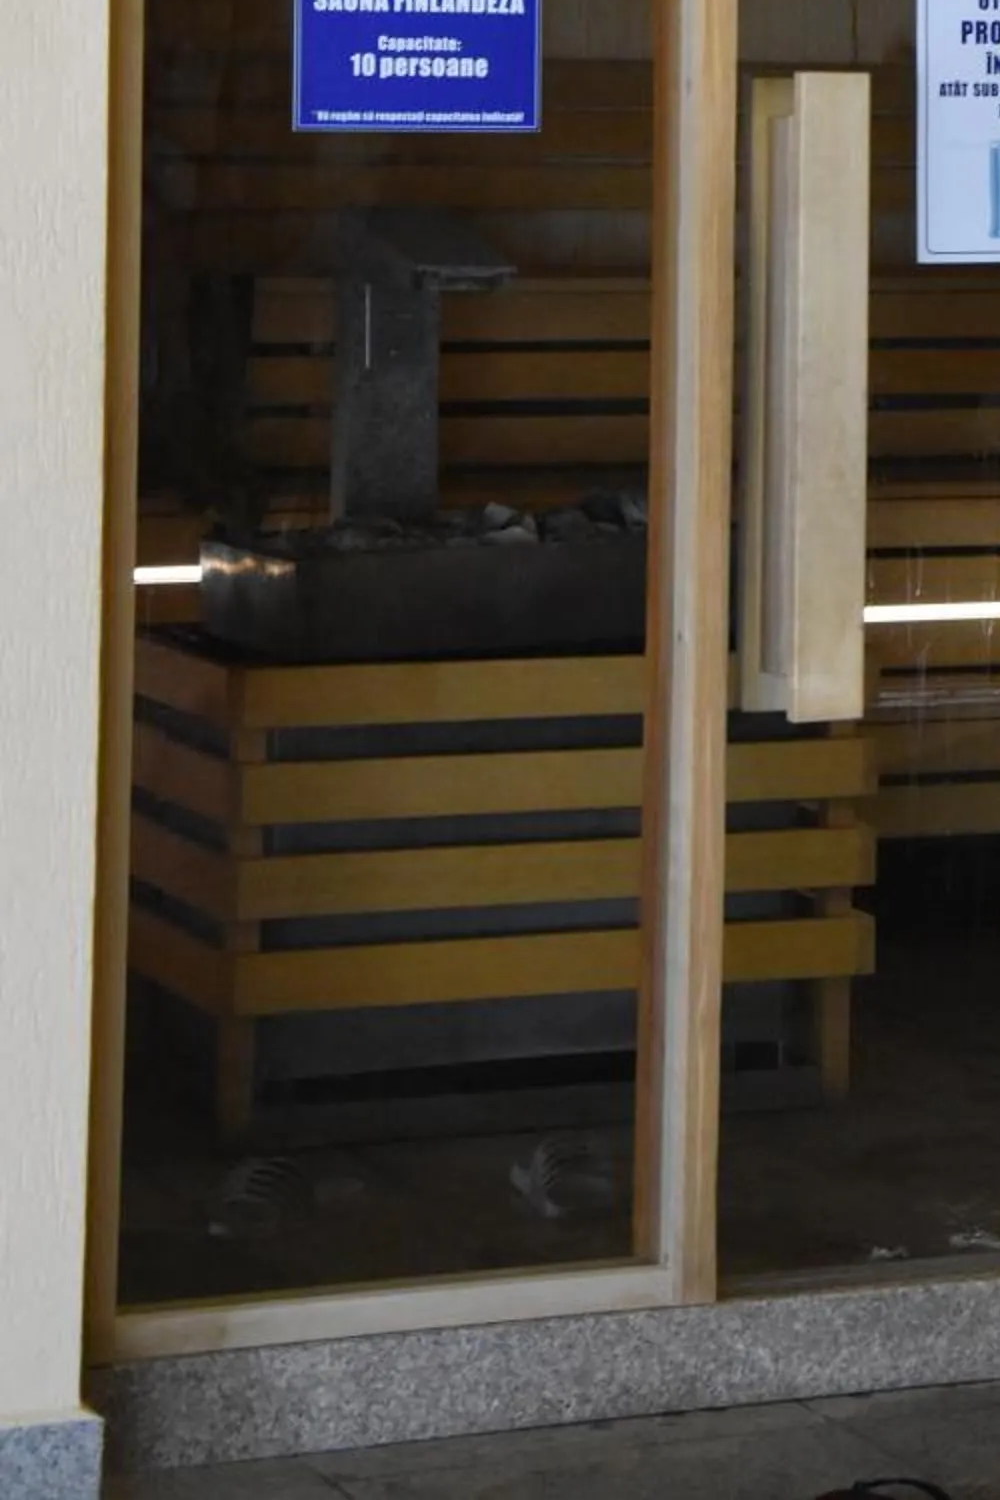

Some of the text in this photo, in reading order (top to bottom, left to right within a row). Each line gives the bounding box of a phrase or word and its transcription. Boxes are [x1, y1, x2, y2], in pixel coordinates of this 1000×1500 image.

[377, 35, 462, 52] Capacitate:
[350, 53, 488, 79] 10 persoane
[939, 80, 967, 97] ATÂT
[973, 83, 999, 97] SUB
